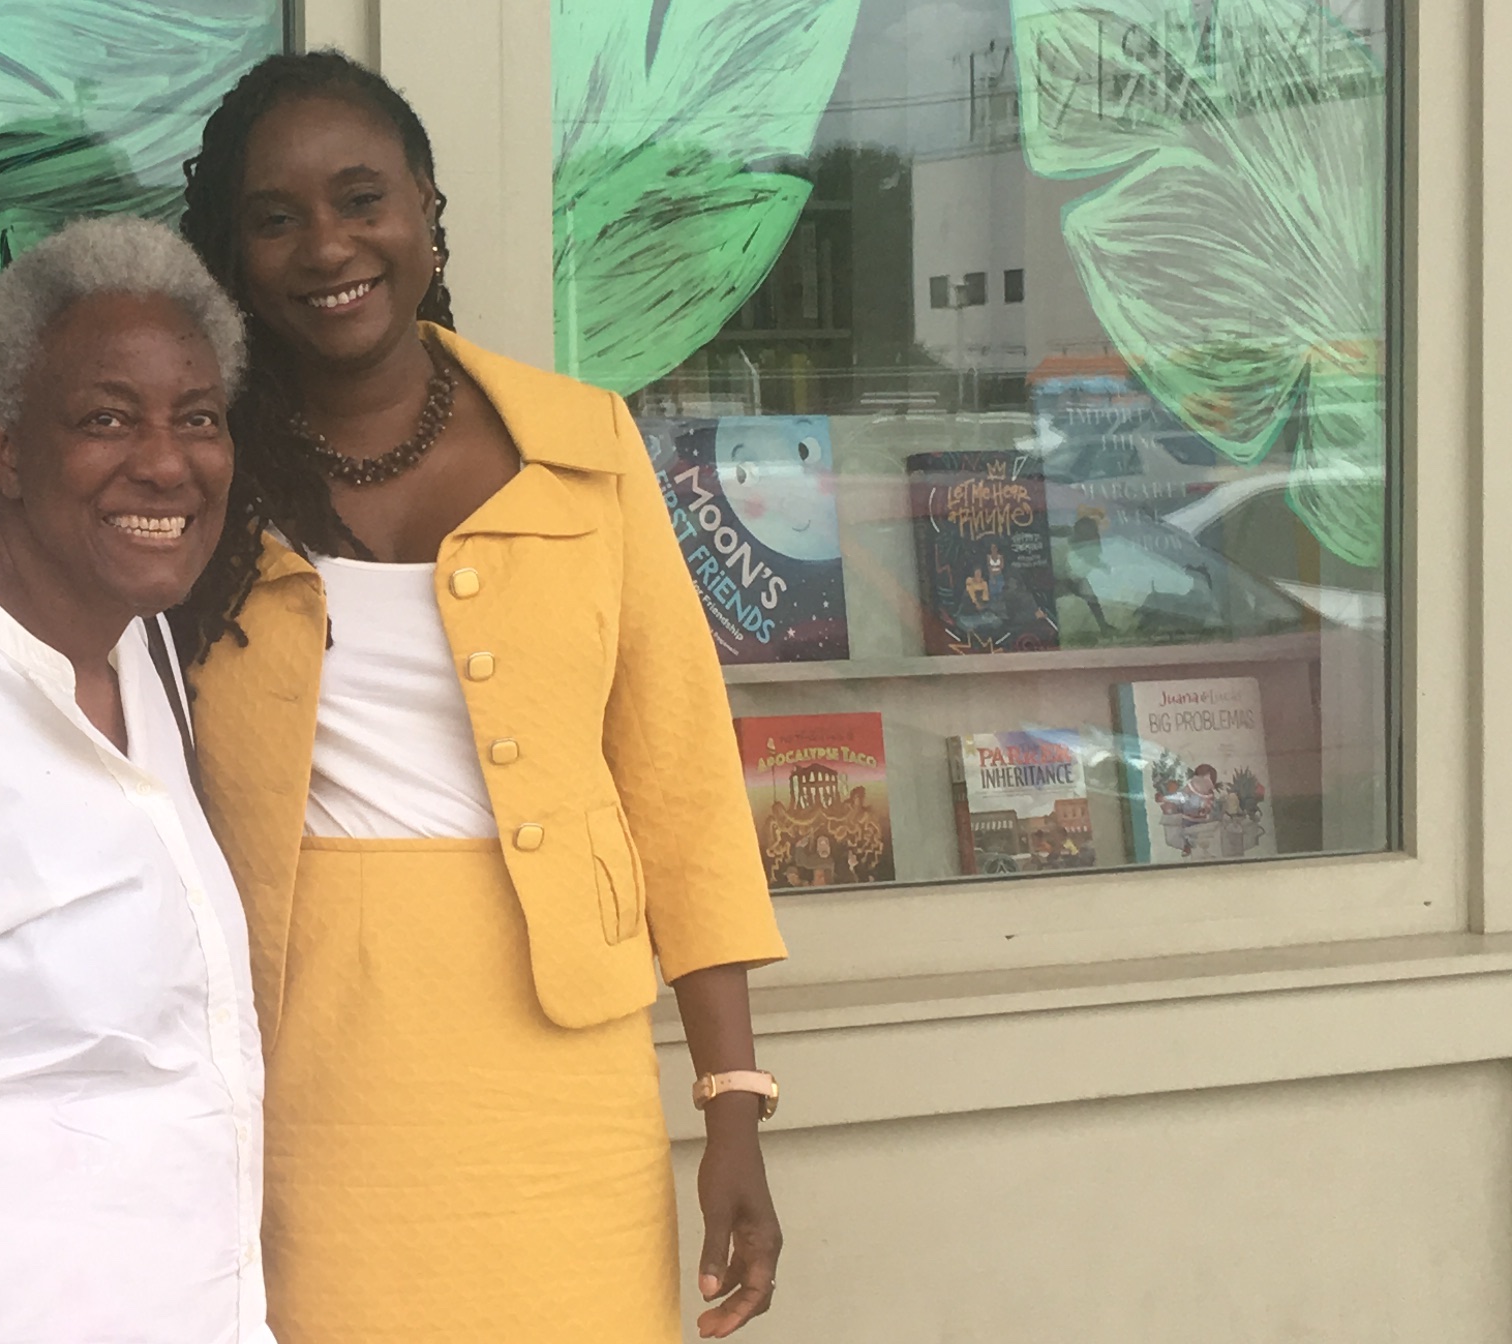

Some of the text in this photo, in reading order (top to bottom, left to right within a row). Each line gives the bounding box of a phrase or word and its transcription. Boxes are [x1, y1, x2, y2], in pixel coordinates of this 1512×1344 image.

[674, 465, 787, 609] MOON'S
[701, 593, 744, 641] Friendship
[1160, 690, 1200, 707] Juana
[1149, 709, 1256, 734] BIG PROBLEMAS
[757, 746, 877, 773] APOCALYPSE TACO
[981, 763, 1074, 789] INHERITANCE
